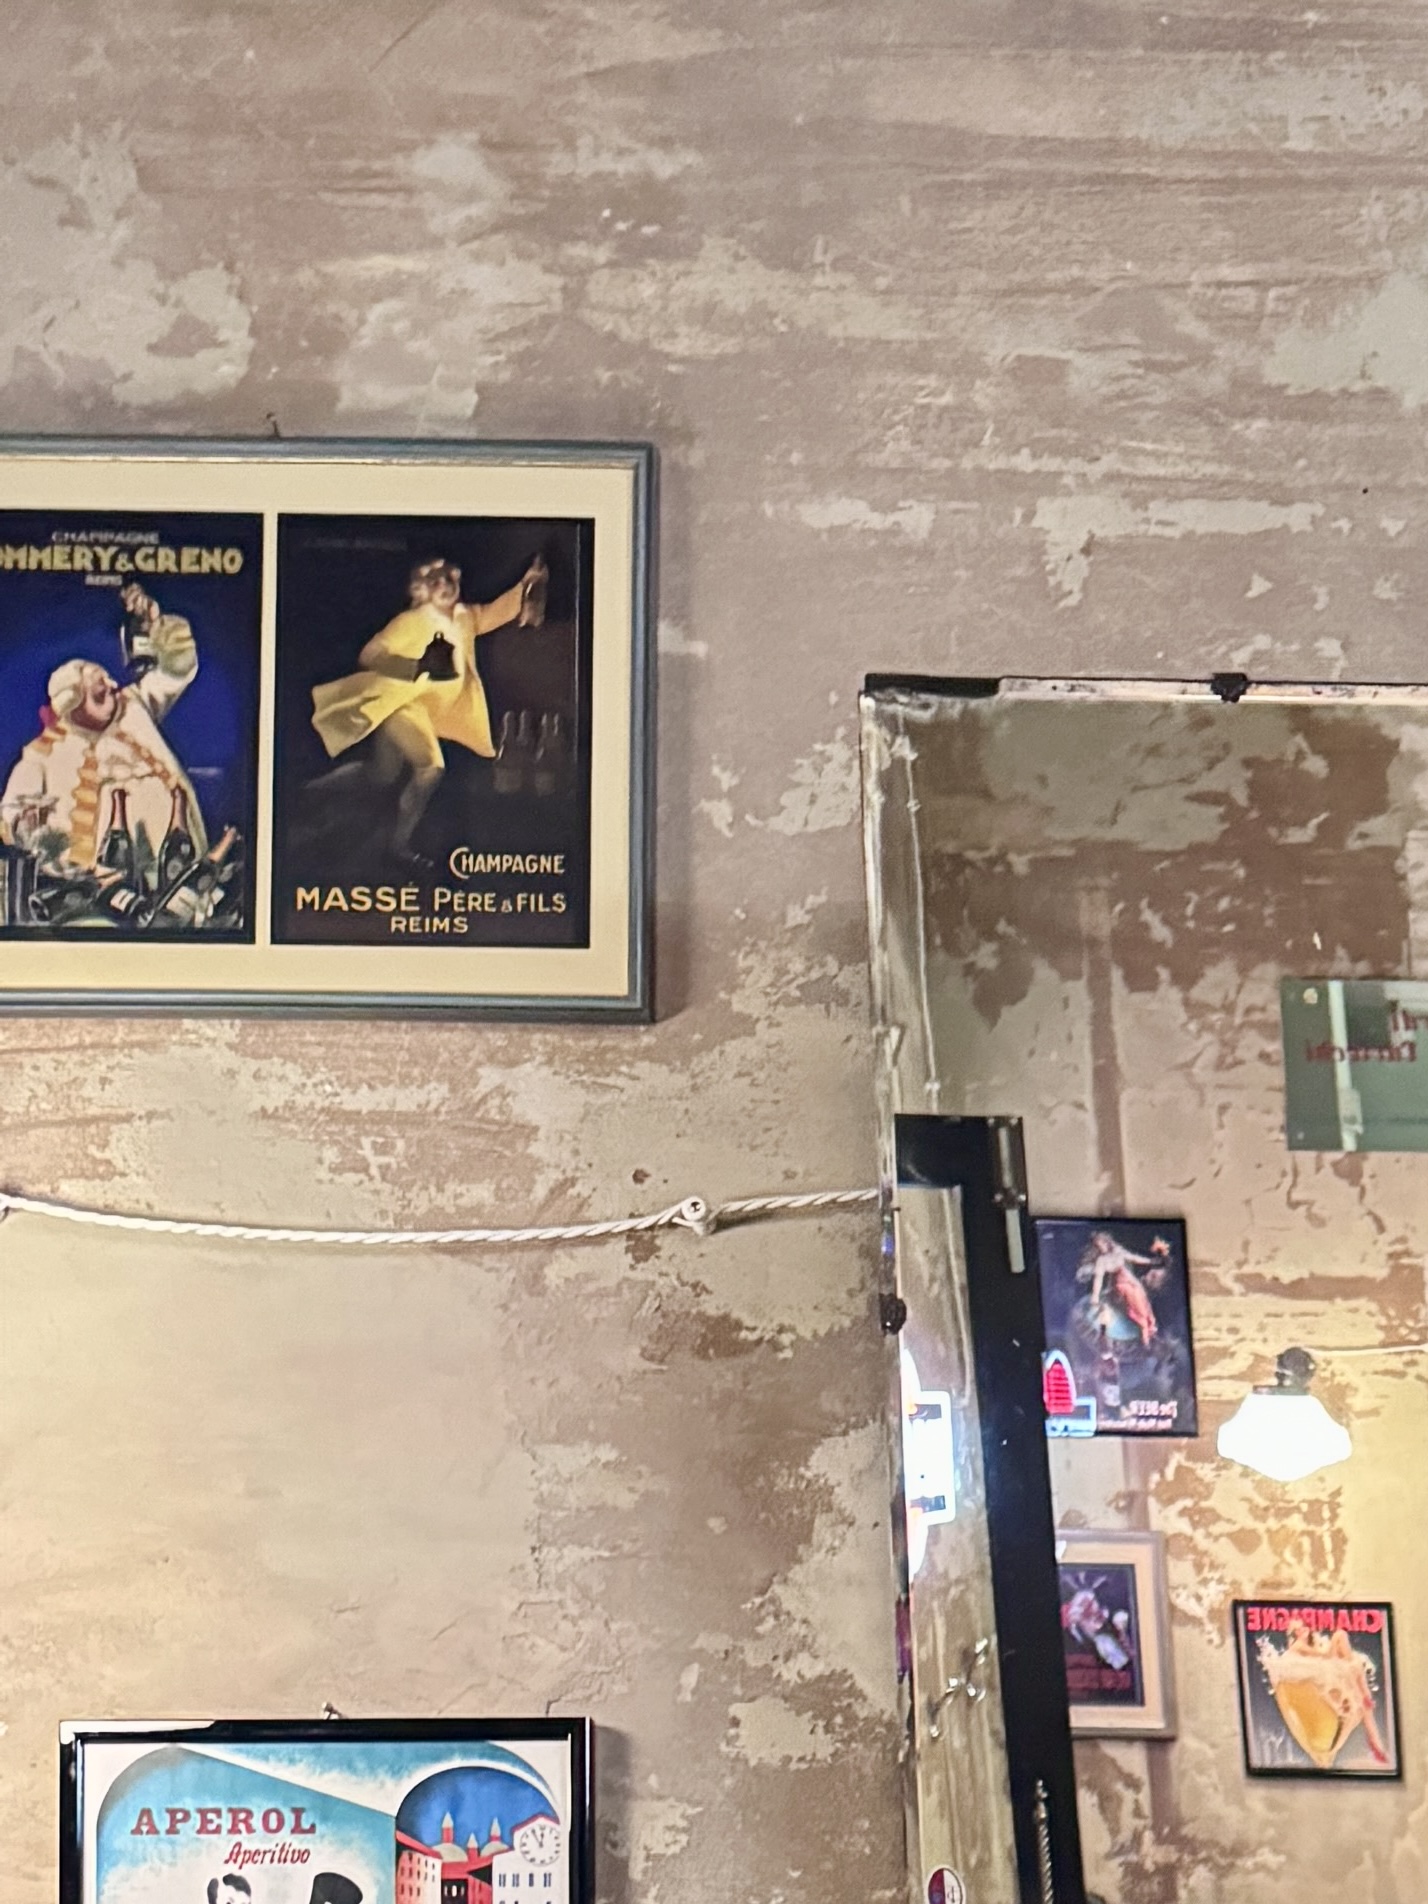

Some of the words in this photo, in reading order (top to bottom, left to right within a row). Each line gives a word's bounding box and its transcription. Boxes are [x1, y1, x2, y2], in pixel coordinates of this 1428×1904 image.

[51, 530, 160, 544] CHAMPAGNE
[450, 846, 565, 880] CHAMPAGNE
[296, 882, 420, 912] MASSÉ
[517, 893, 567, 913] FILS
[390, 916, 469, 934] REIMS
[131, 1807, 317, 1836] APEROL
[224, 1840, 311, 1869] Aperitivo
